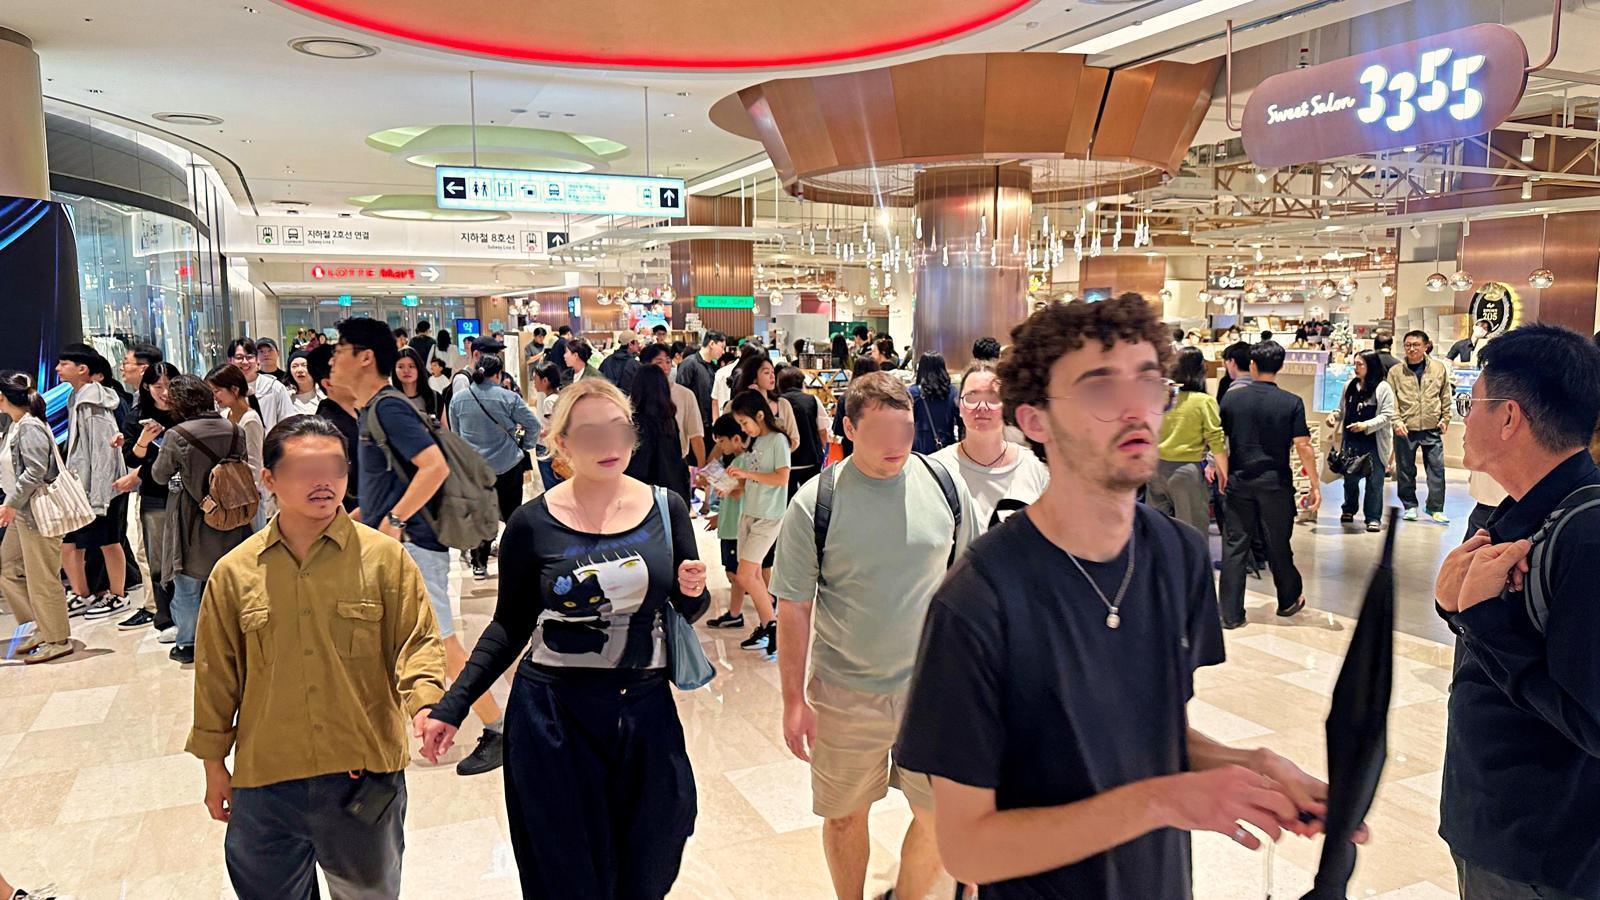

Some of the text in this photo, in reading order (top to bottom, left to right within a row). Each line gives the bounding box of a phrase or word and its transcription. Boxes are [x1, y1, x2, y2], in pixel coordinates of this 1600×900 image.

[1267, 48, 1486, 132] Sweet Salon 3355
[307, 230, 369, 240] 지하철 2호선 연결
[461, 232, 515, 244] 지하철 8호선
[328, 267, 415, 279] LOTTE Mart
